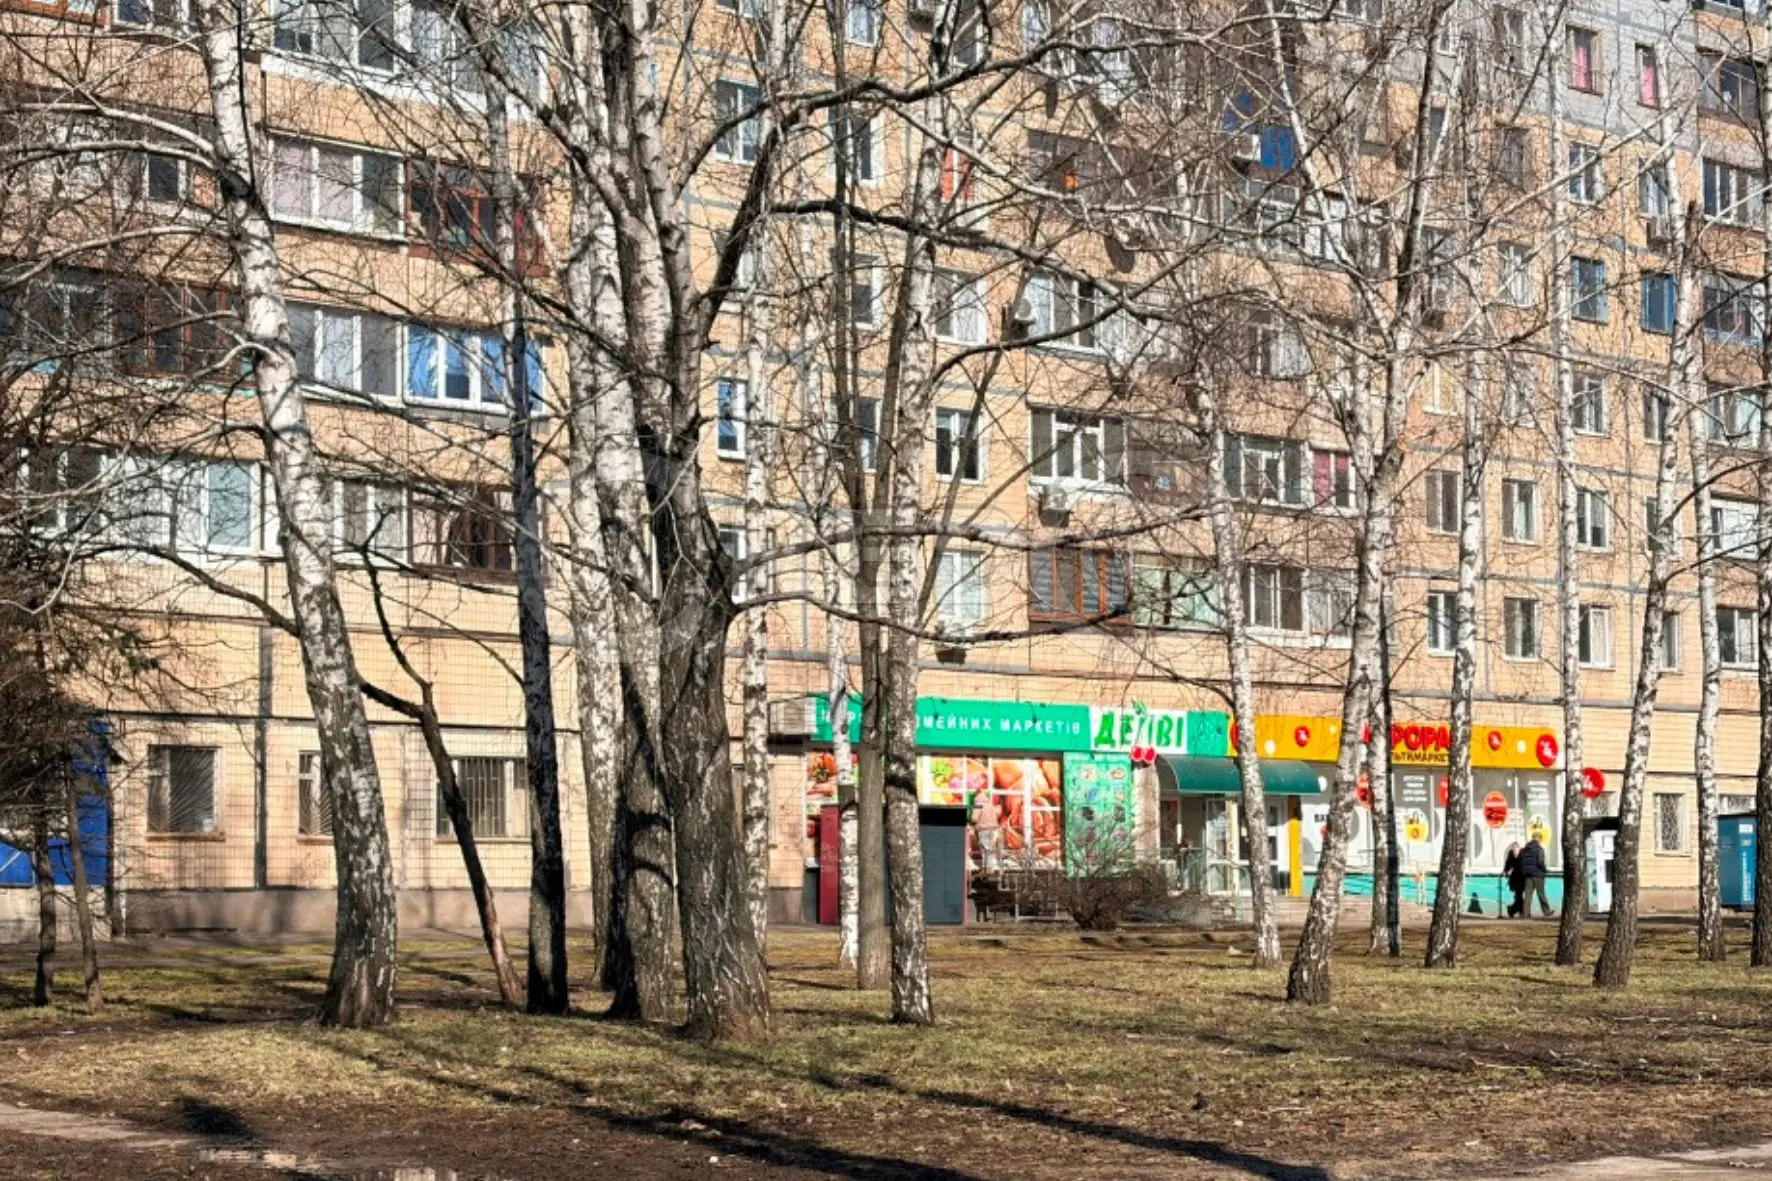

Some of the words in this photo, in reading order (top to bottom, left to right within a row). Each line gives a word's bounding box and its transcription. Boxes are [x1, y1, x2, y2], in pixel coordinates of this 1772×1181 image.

[915, 713, 992, 732] ІМЕЙНИХ
[1000, 717, 1081, 735] МАРКЕТІВ
[1391, 723, 1451, 751] РОРА
